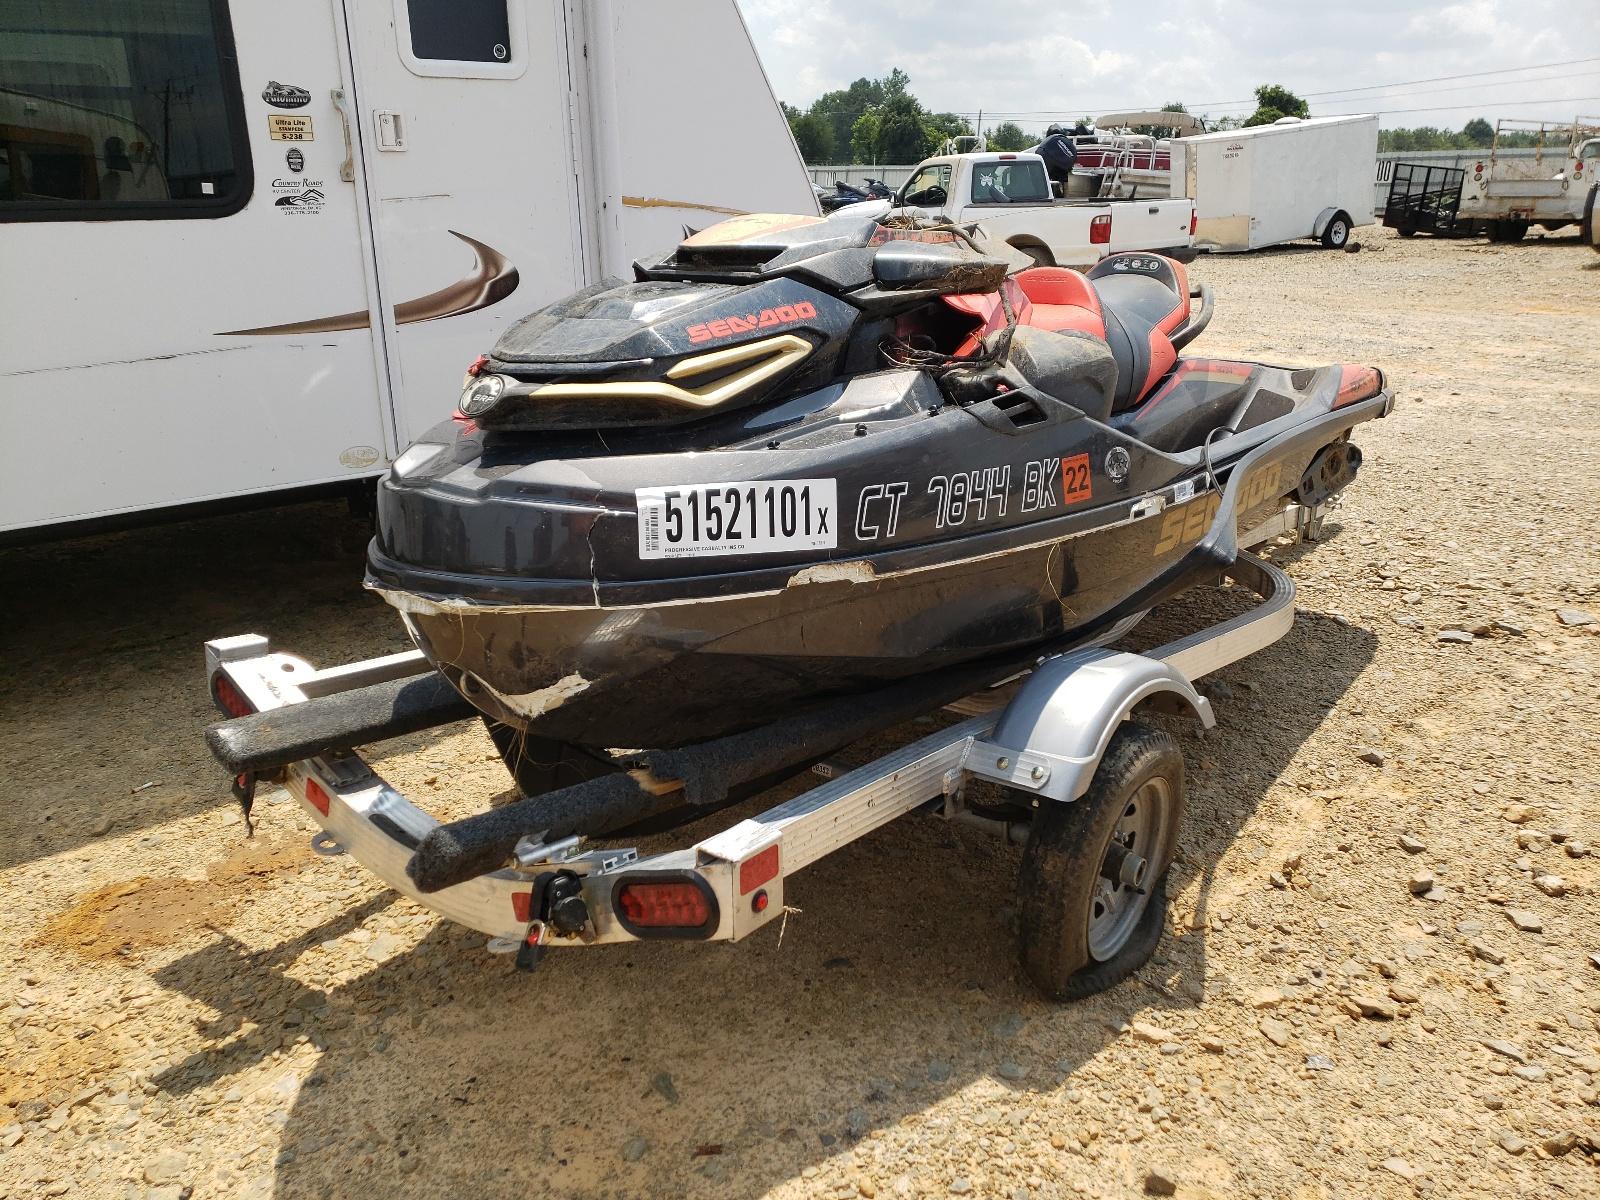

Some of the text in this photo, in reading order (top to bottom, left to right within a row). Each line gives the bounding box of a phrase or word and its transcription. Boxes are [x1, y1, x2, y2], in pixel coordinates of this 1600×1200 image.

[472, 394, 495, 403] BRP
[854, 457, 1061, 542] CT 7844 BK
[1065, 463, 1089, 494] 22
[664, 485, 811, 543] 51521101
